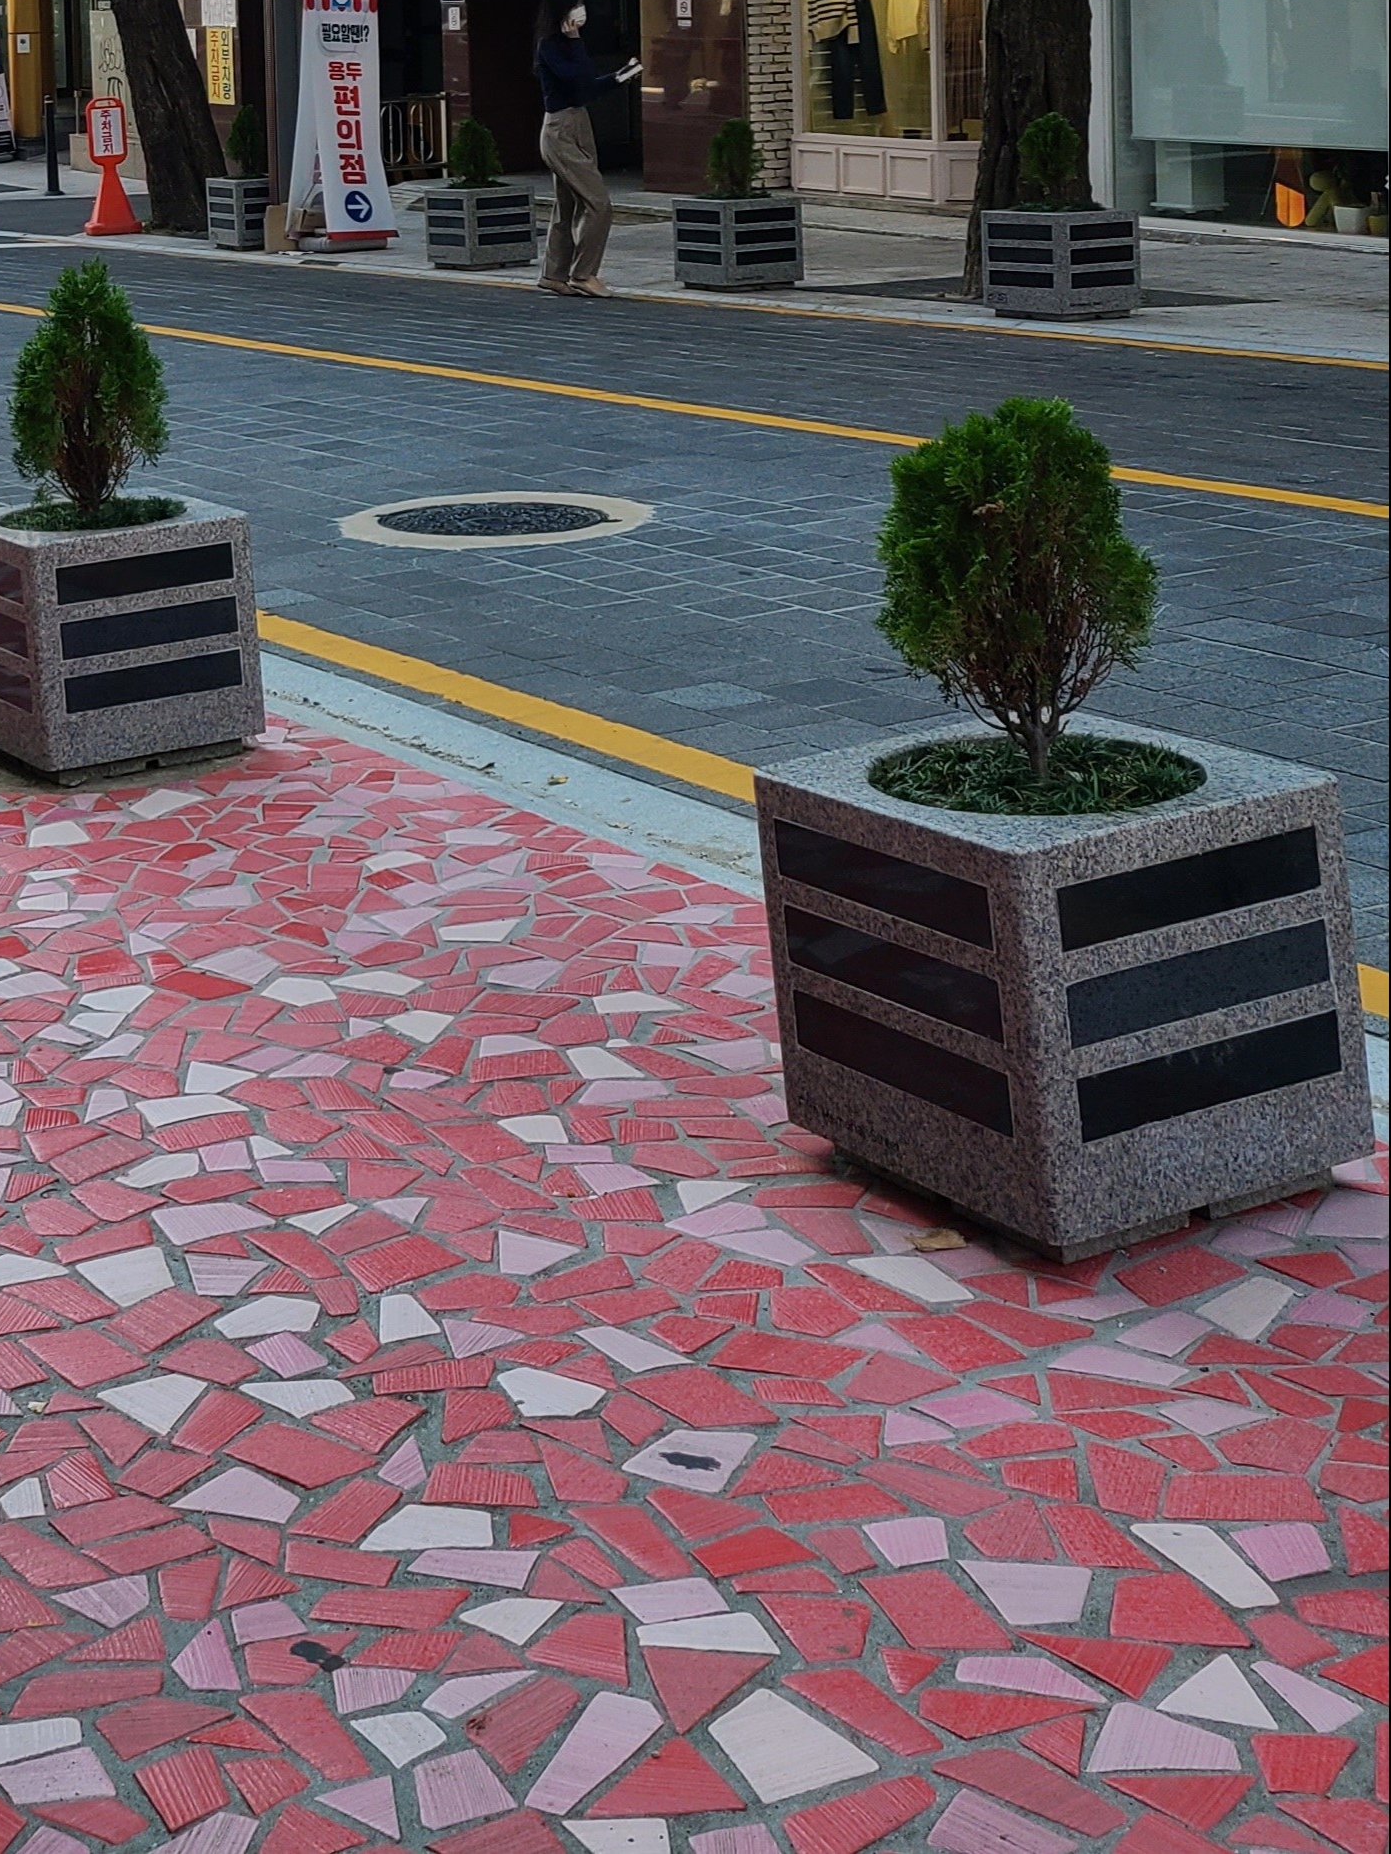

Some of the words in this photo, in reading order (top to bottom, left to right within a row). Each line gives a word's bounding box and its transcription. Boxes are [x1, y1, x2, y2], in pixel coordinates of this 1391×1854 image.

[321, 22, 370, 44] 필요할땐!?
[210, 30, 220, 99] 주차금지
[221, 30, 232, 100] 외부차량
[328, 60, 363, 81] 용두
[100, 109, 114, 155] 주차금지
[333, 84, 368, 185] 편의점
